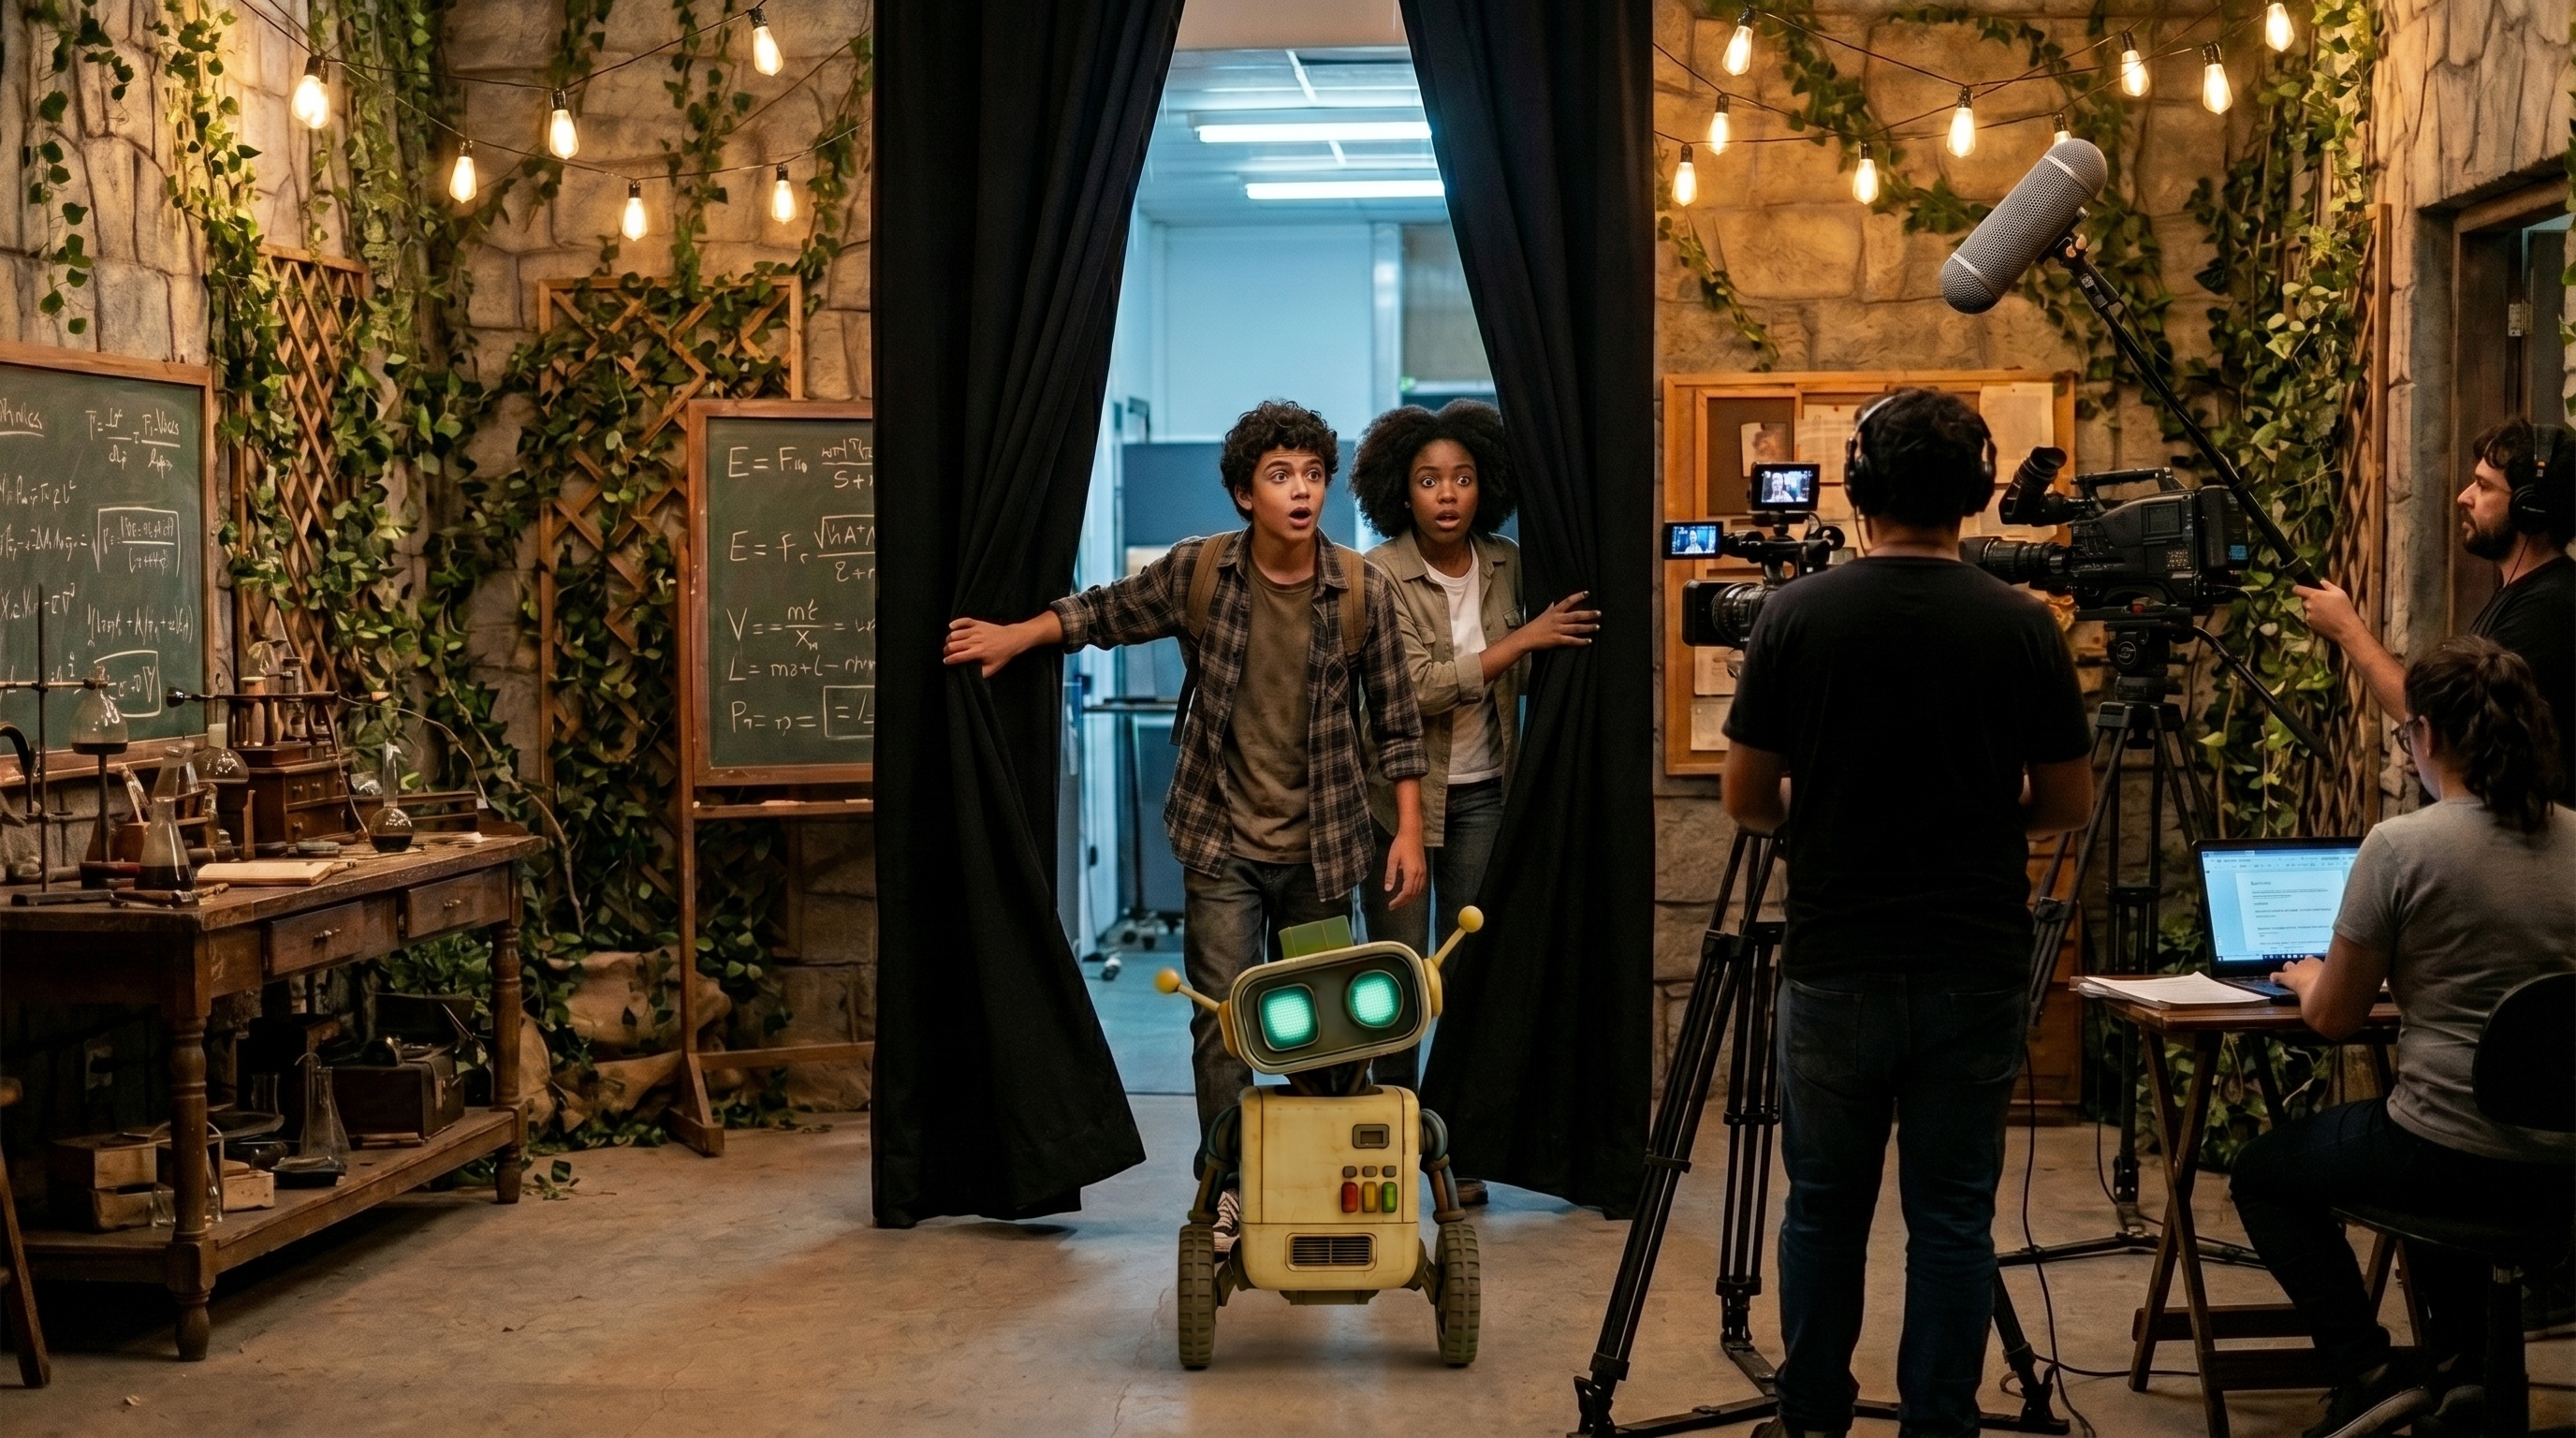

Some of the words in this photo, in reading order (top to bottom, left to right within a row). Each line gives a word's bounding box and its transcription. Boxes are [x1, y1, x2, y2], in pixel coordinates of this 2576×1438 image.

[728, 447, 750, 477] E
[730, 530, 749, 562] E
[726, 608, 748, 641] V
[728, 655, 747, 681] L
